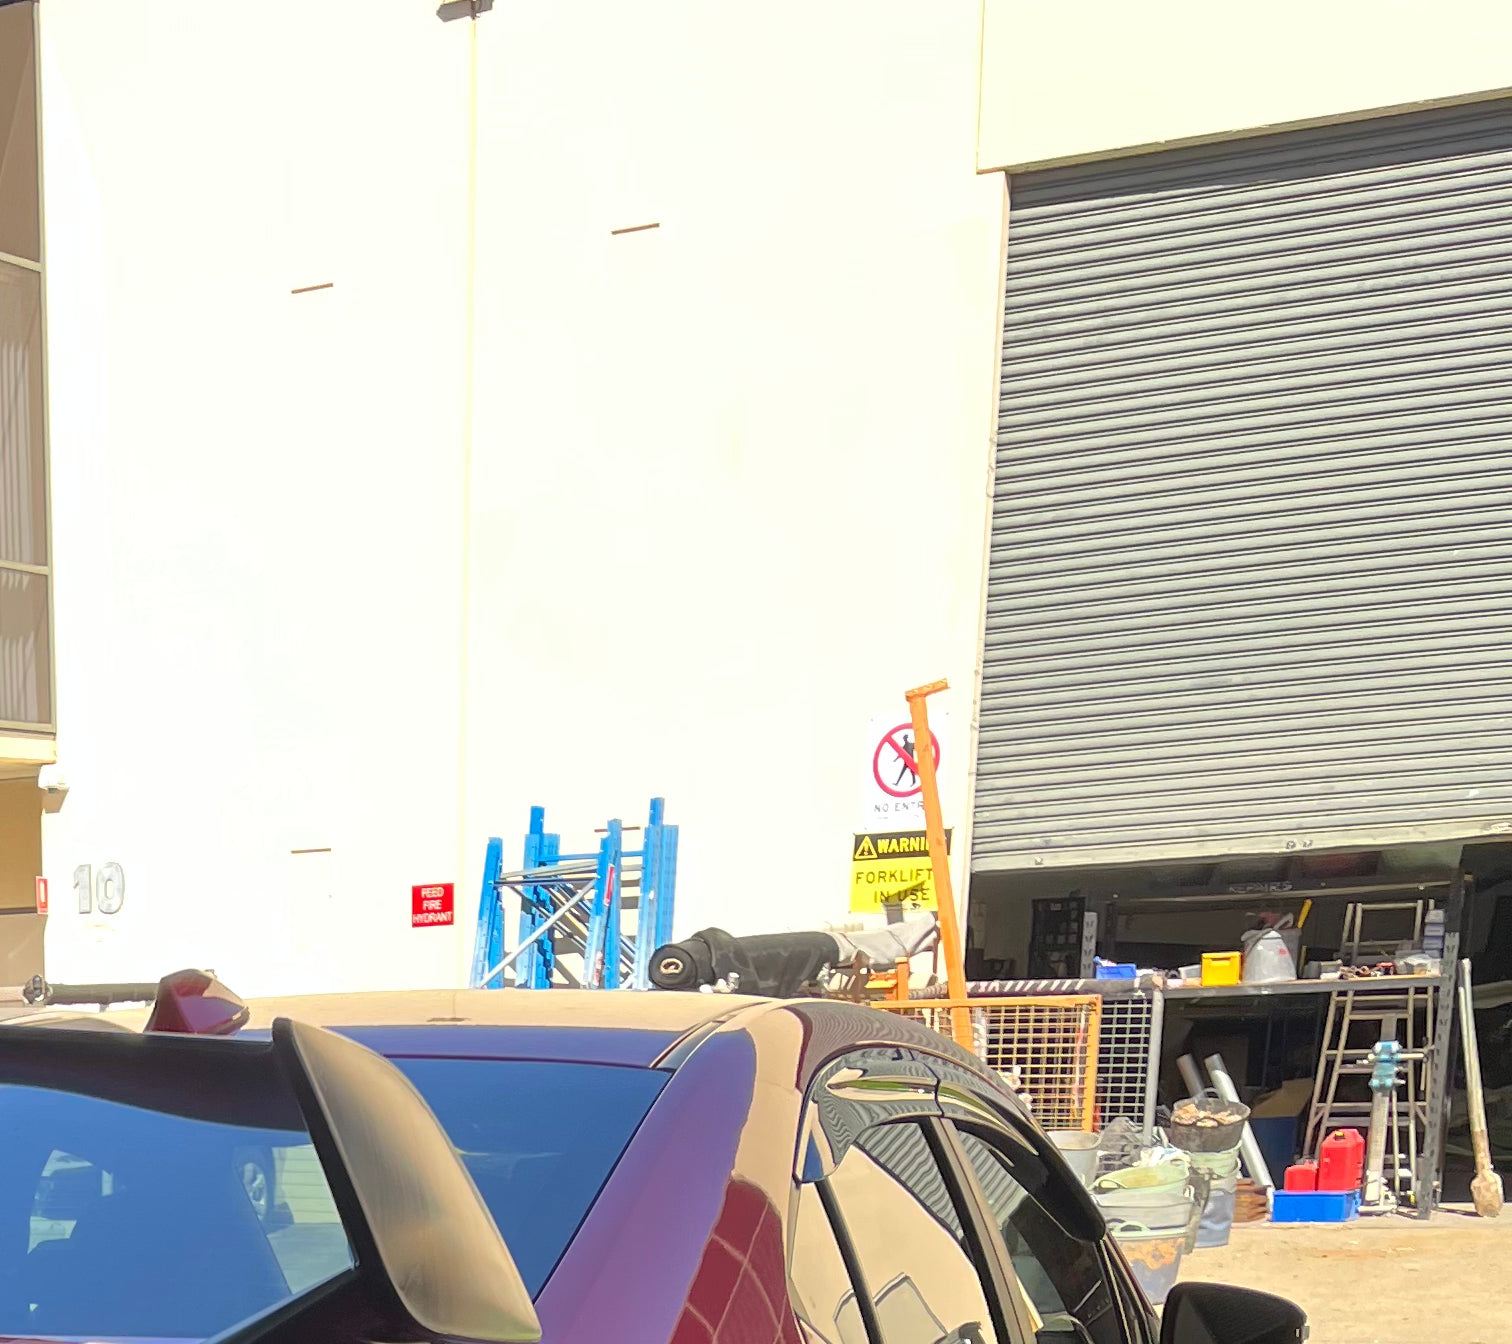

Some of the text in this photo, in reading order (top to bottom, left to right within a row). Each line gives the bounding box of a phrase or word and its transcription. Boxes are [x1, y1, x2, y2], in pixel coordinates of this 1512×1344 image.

[874, 801, 925, 813] NO ENTR
[877, 836, 929, 853] WARNI
[856, 868, 933, 884] FORKLIFT
[73, 862, 125, 915] 10
[898, 888, 930, 901] USE
[422, 899, 443, 910] FIRE
[413, 911, 452, 923] HYDRANT
